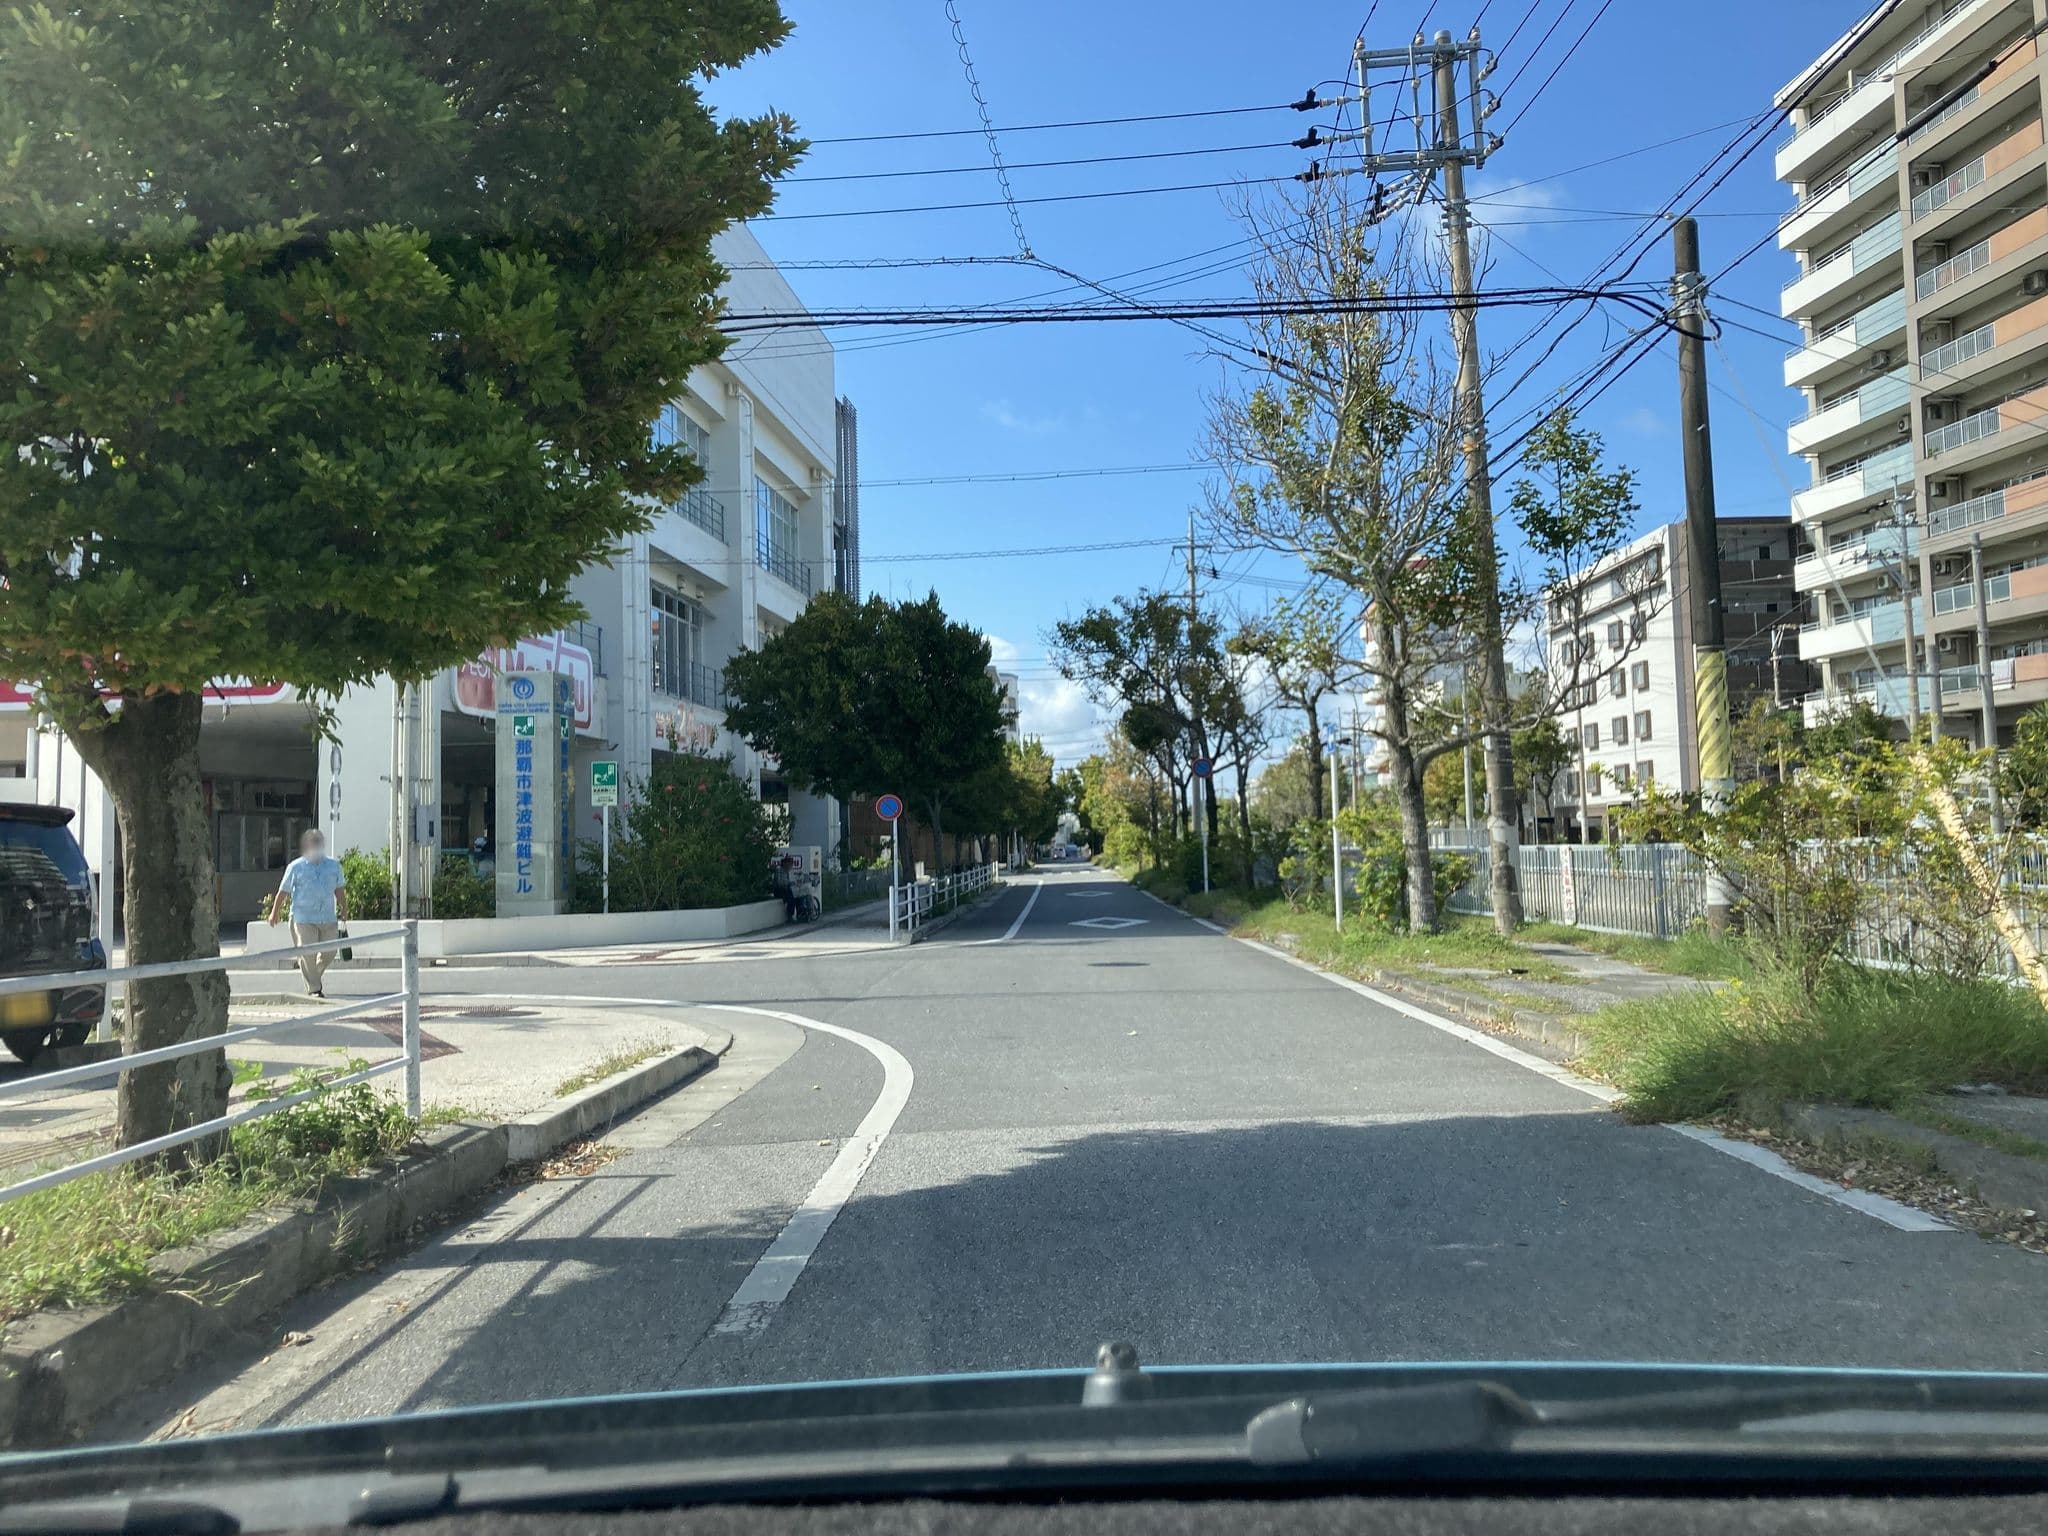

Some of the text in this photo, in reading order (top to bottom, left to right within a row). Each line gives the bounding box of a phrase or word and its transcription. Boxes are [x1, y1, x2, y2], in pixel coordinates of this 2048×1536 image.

[515, 739, 533, 894] 那覇市津波避難ビル
